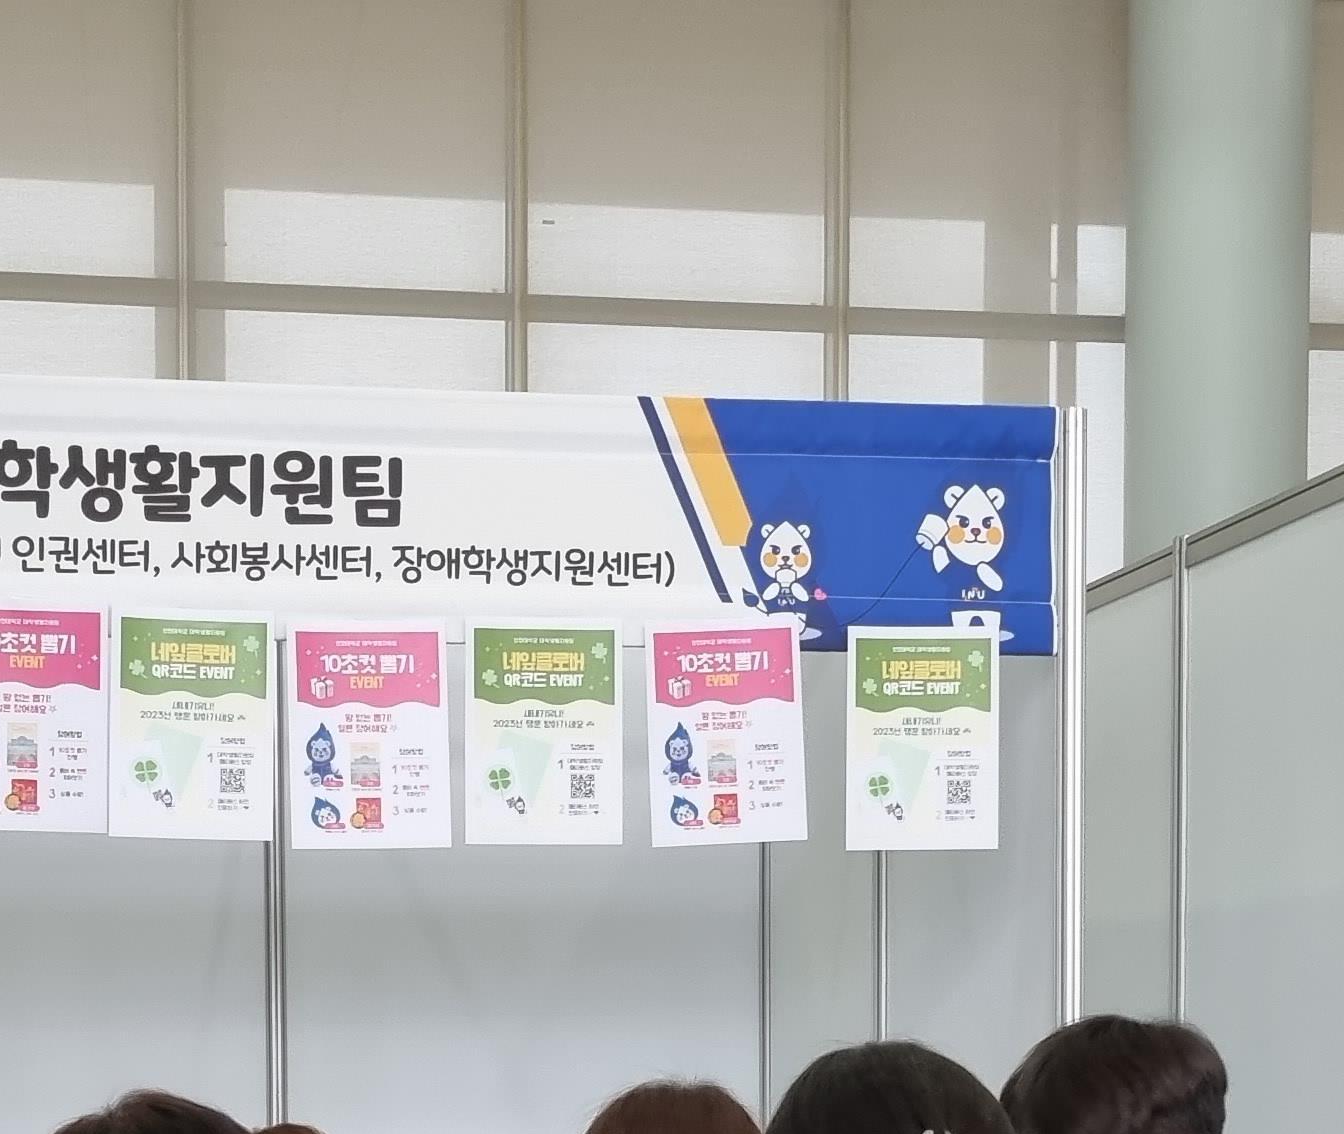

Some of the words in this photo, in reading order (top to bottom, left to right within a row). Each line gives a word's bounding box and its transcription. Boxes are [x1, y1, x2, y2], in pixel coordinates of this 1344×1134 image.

[13, 535, 160, 577] 인권센터,
[171, 540, 382, 583] 사회봉사센터,
[392, 545, 675, 588] 장애학생지원센터)
[10, 655, 45, 669] EVENT
[320, 655, 376, 674] 10초컷
[677, 653, 732, 672] 10초컷
[152, 664, 197, 679] QR코드
[200, 666, 235, 679] EVENT
[350, 676, 384, 689] EVENT
[504, 672, 546, 687] QR코드
[550, 674, 584, 687] EVENT
[706, 673, 739, 687] EVENT
[883, 681, 924, 695] QR코드
[927, 682, 961, 694] EVENT
